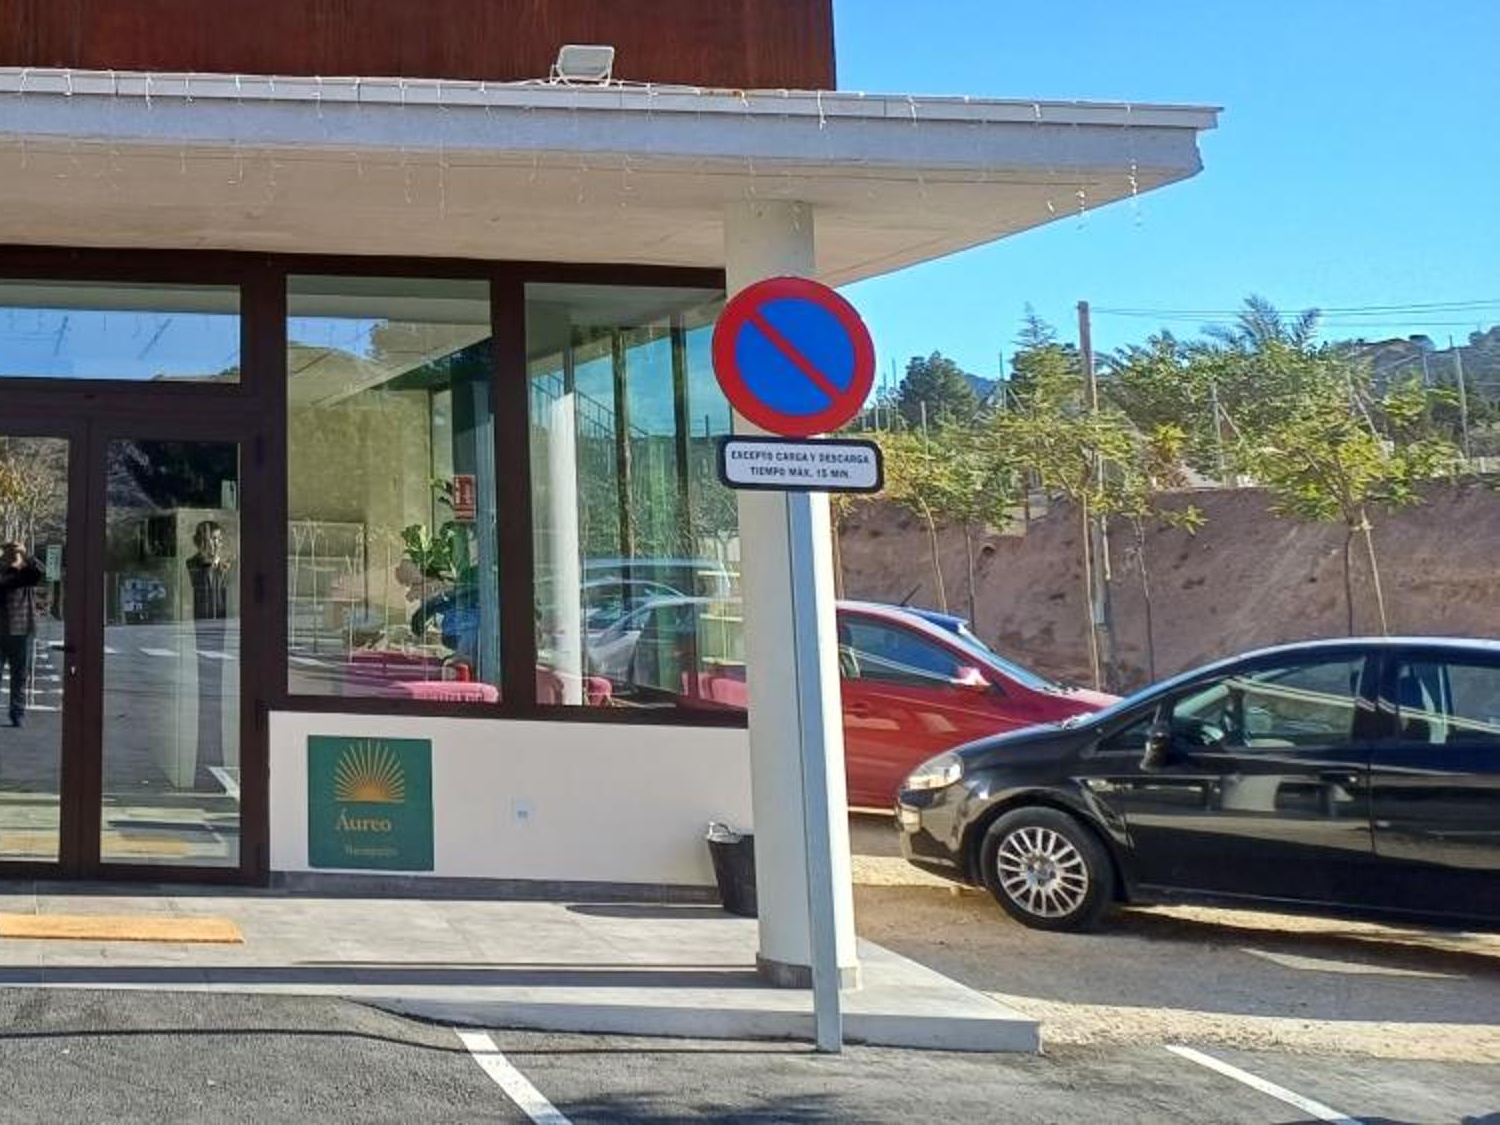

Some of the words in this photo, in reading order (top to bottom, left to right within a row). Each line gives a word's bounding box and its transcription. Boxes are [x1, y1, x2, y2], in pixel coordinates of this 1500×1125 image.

[731, 450, 773, 462] EXCEPTO
[775, 452, 808, 462] CARGA
[809, 453, 816, 462] Y
[819, 453, 870, 464] DESCARGA
[750, 466, 786, 476] TIEMPO
[816, 469, 828, 478] 15
[335, 807, 393, 832] Áureo
